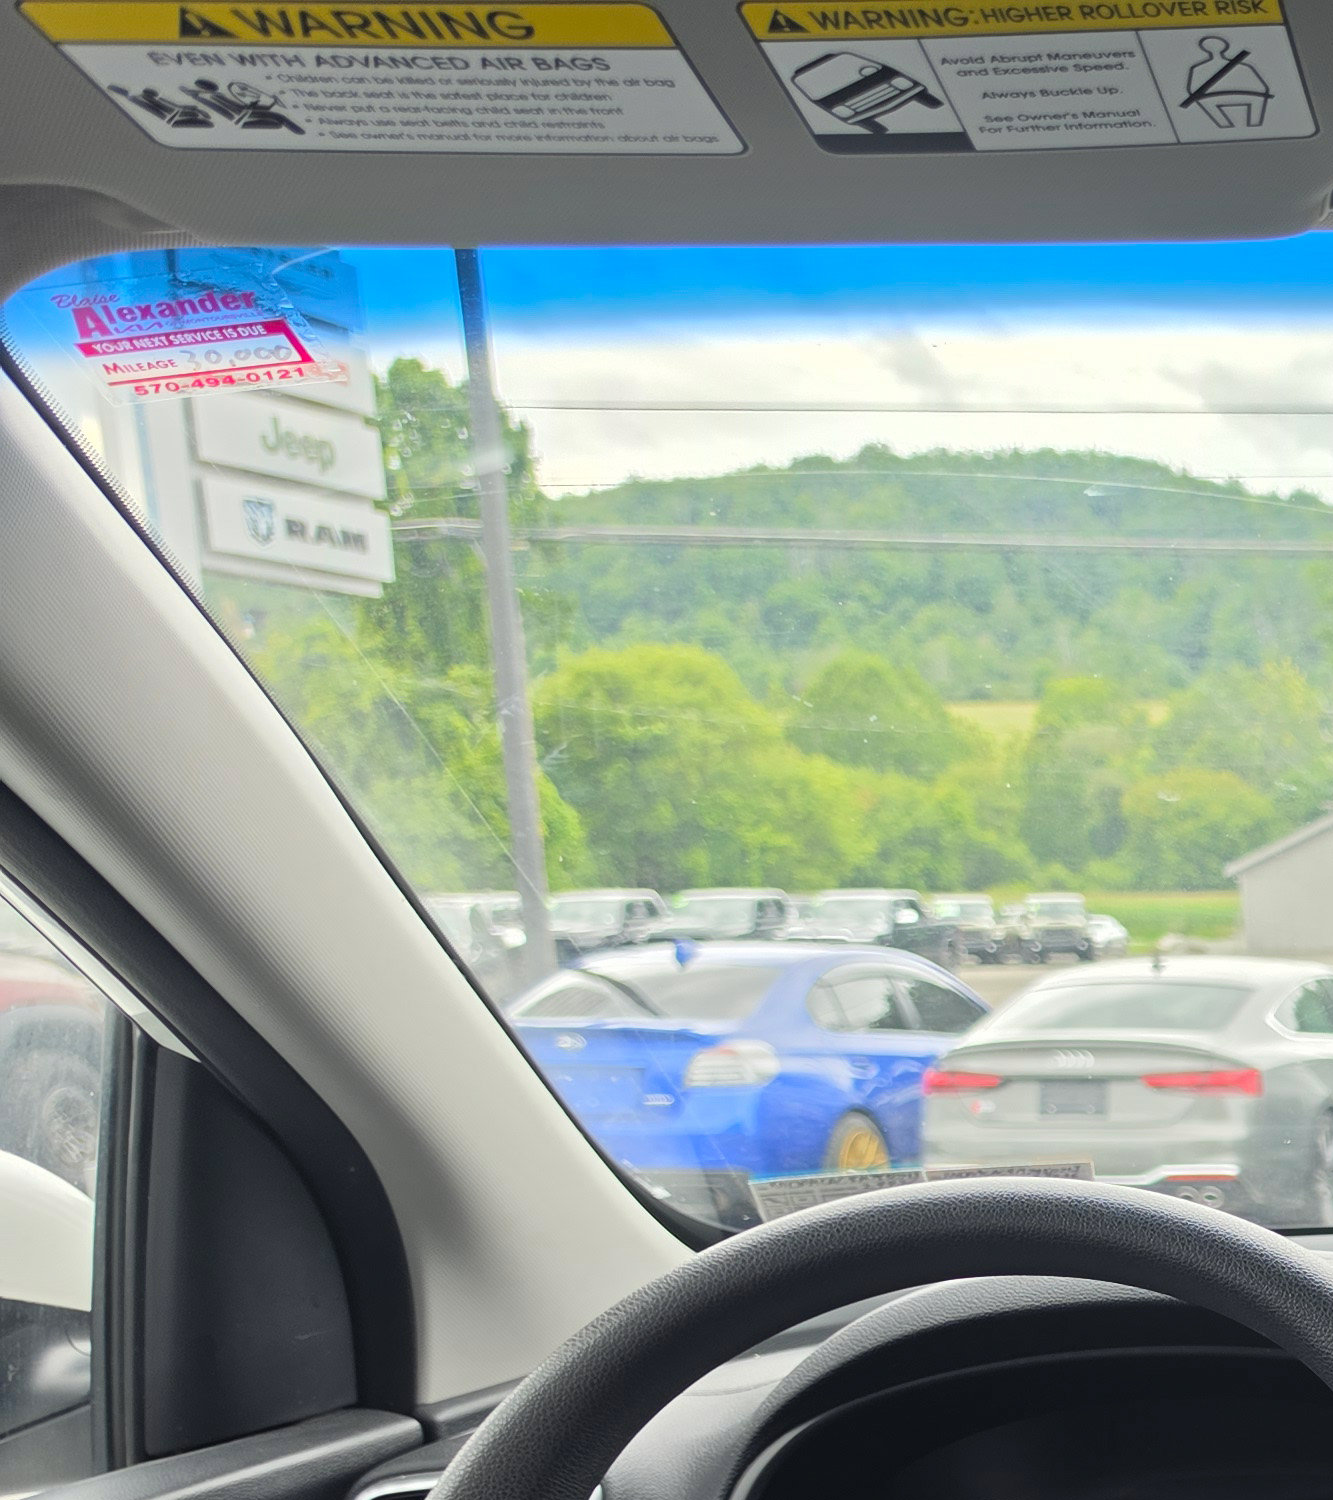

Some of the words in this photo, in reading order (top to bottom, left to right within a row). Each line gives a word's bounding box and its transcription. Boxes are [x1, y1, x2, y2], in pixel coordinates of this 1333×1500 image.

[980, 5, 1073, 24] HIGHER
[1079, 2, 1208, 21] ROLLOVER
[1215, 0, 1268, 15] RISK
[232, 8, 536, 41] WARNING
[147, 51, 226, 67] EVEN
[230, 52, 308, 68] WITH
[314, 54, 471, 71] ADVANCED
[481, 55, 527, 71] AIR
[533, 56, 612, 72] BAGS
[941, 55, 985, 66] Avoid
[990, 53, 1043, 66] Abrupt
[1046, 50, 1136, 62] Maneuvers
[957, 67, 989, 77] and
[992, 65, 1069, 76] Excessive
[1073, 62, 1129, 73] Speed.
[277, 73, 337, 84] Children
[341, 76, 371, 85] can
[373, 75, 394, 85] be
[572, 78, 593, 89] by
[595, 77, 619, 88] the
[623, 78, 641, 88] air
[643, 77, 676, 88] bag
[362, 90, 394, 99] seat
[411, 91, 437, 99] the
[554, 91, 612, 101] children
[982, 89, 1036, 100] Always
[1039, 87, 1093, 98] Buckle
[1097, 86, 1124, 96] Up.
[562, 106, 588, 116] the
[589, 106, 624, 116] front
[984, 114, 1014, 123] See
[1017, 112, 1080, 122] Owner's
[1083, 109, 1140, 120] Manual
[318, 117, 369, 127] Always
[979, 125, 1003, 134] For
[1007, 123, 1061, 133] Further
[1064, 120, 1157, 131] Information.
[51, 293, 120, 309] Blaise
[72, 291, 256, 339] Alexander
[92, 340, 135, 355] YOUR
[133, 335, 171, 351] NEXT
[169, 330, 223, 346] SERVICE
[222, 328, 238, 341] IS
[240, 324, 267, 338] DUE
[134, 366, 305, 396] 570-494-0121
[261, 415, 336, 476] Jeep
[283, 517, 369, 554] RAM
